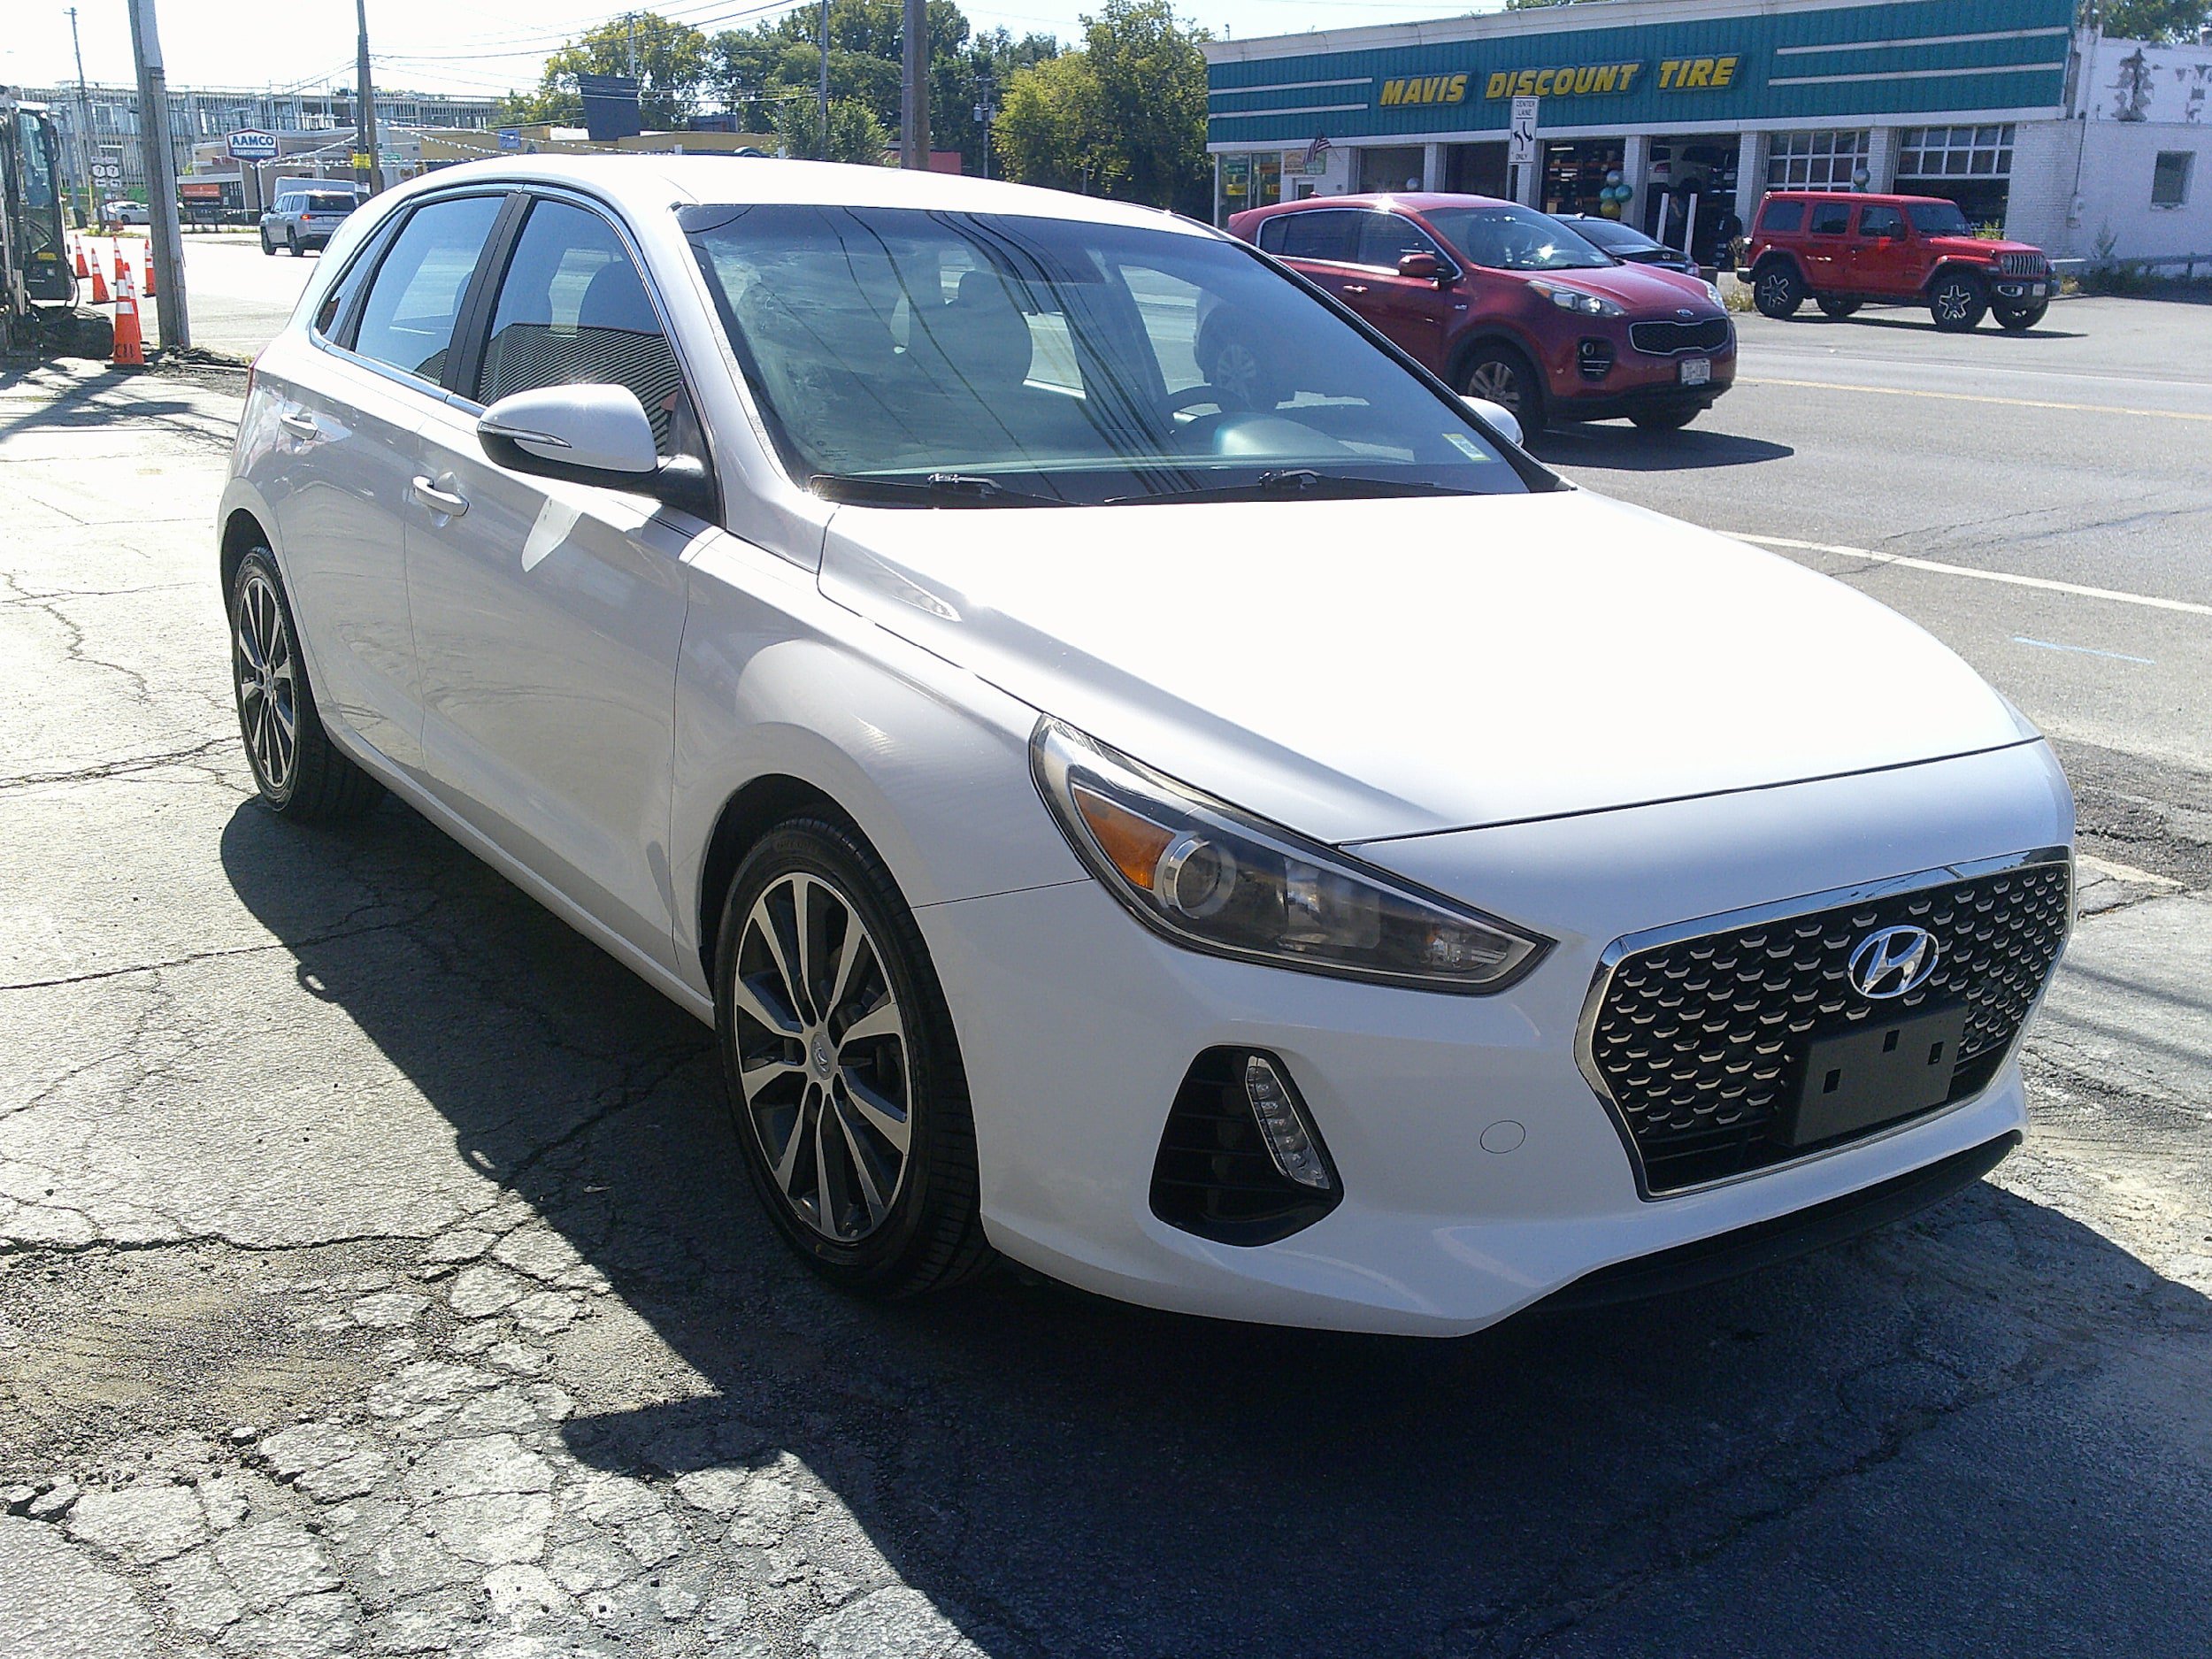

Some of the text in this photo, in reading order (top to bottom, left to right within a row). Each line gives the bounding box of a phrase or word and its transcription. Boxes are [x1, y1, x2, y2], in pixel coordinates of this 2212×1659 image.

[1379, 57, 1739, 106] MAVIS DISCOUNT TIRE
[232, 135, 274, 146] AAMCO
